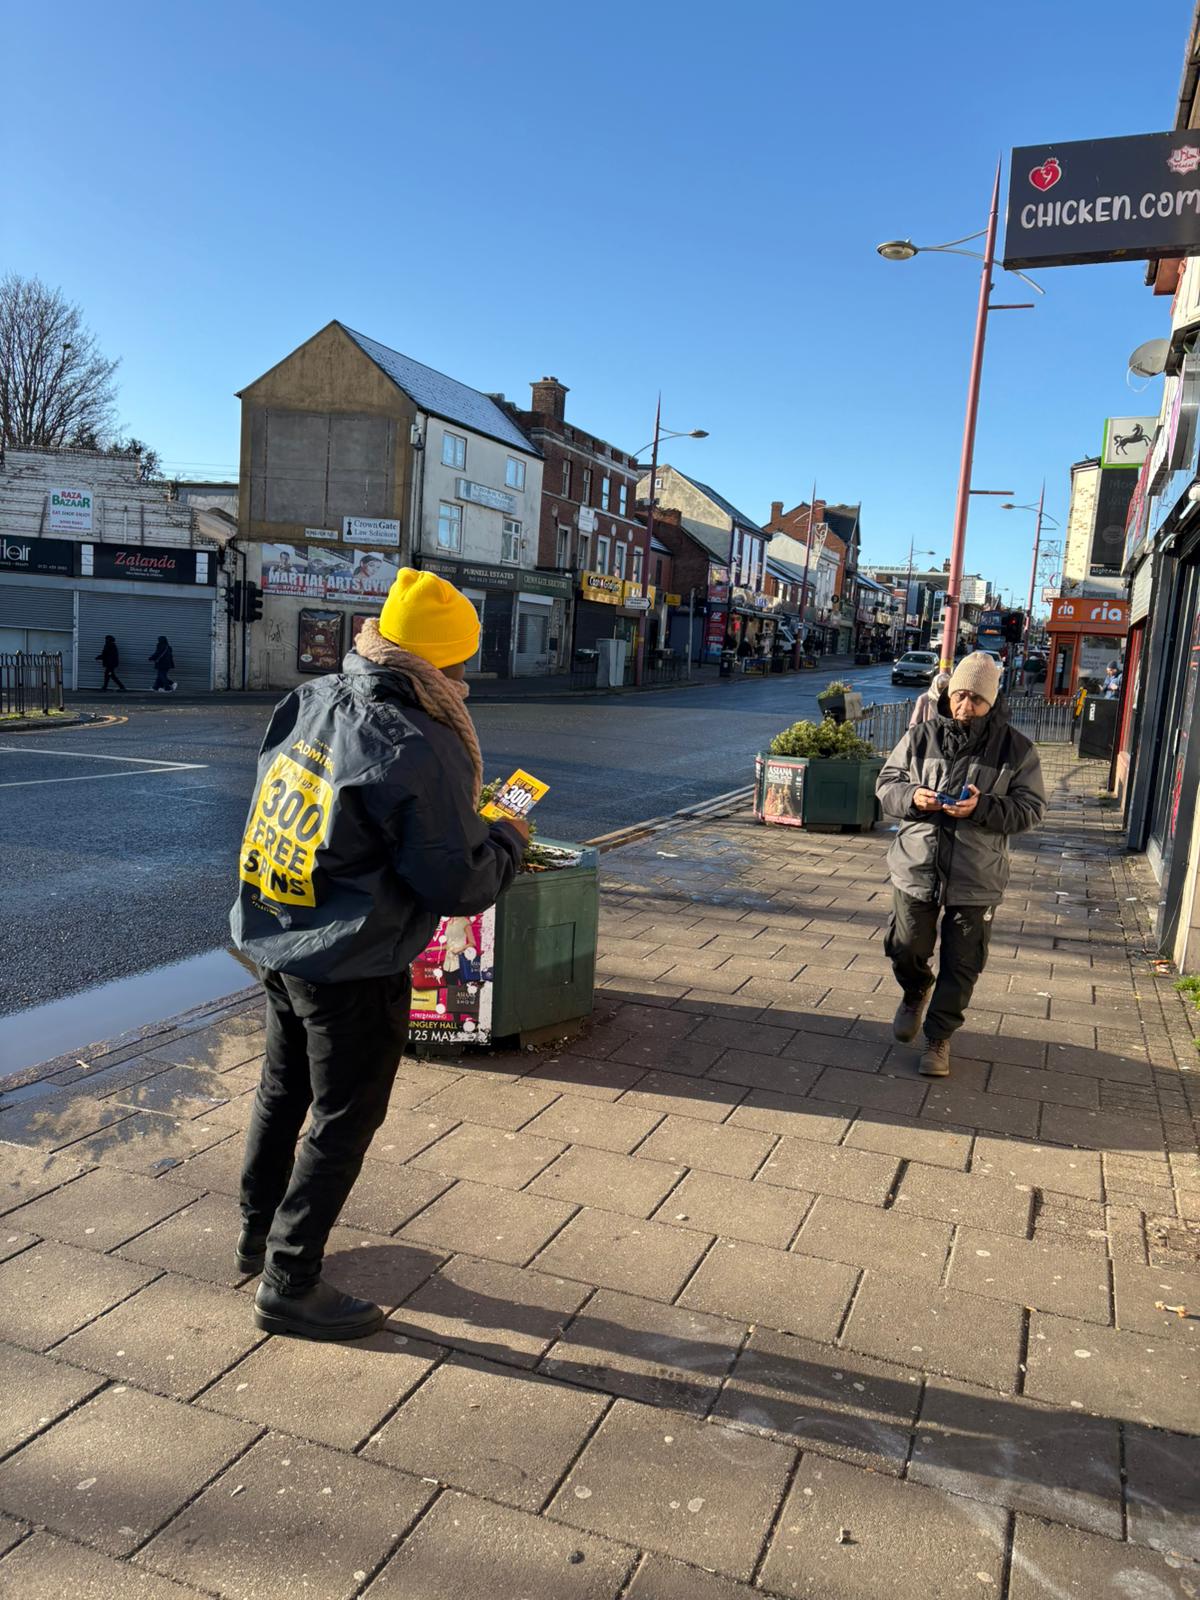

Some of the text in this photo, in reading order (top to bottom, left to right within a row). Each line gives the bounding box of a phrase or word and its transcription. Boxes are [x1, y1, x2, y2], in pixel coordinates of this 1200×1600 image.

[52, 495, 91, 508] BAZAAR
[61, 491, 82, 499] RAZA
[114, 551, 176, 569] Zalanda
[268, 569, 325, 588] MARTIAL
[326, 575, 360, 591] ARTS
[463, 567, 489, 577] PURNELL
[489, 571, 514, 580] ESTATES
[1057, 601, 1074, 615] ria
[1090, 601, 1122, 621] ria
[504, 785, 532, 807] 300
[262, 778, 324, 842] 300
[253, 818, 307, 875] FREE
[440, 1022, 457, 1030] HALL
[414, 1030, 428, 1041] 25
